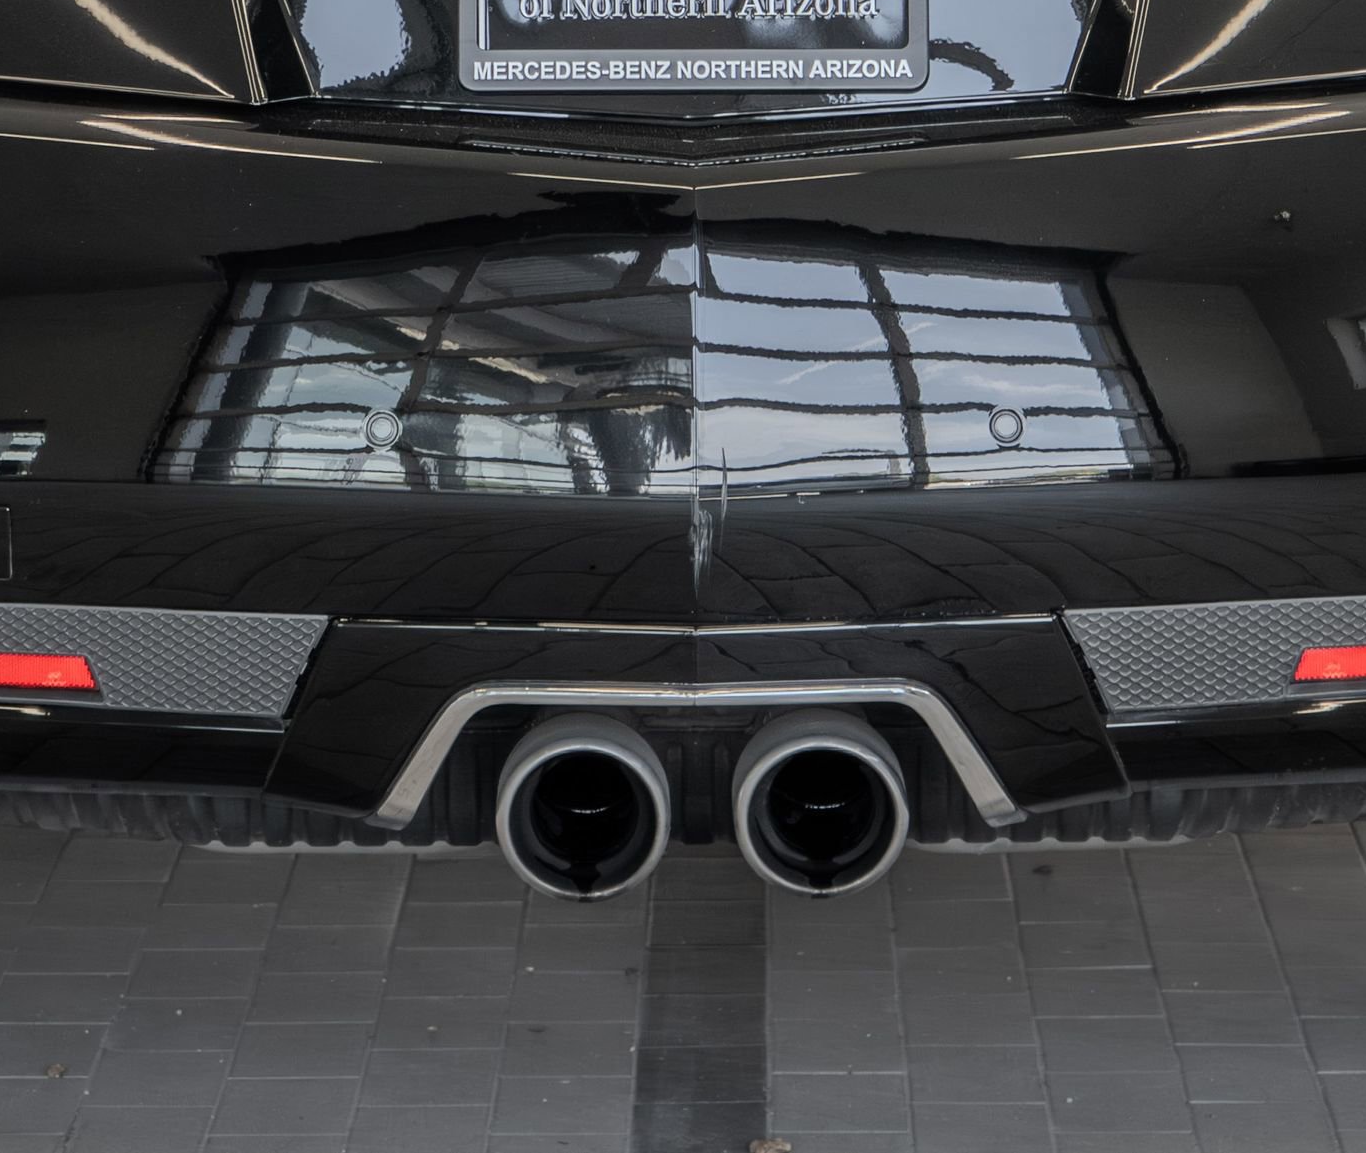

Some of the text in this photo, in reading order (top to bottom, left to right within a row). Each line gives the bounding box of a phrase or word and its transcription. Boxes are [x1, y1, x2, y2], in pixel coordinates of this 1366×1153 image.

[473, 59, 914, 81] MERCEDES-BENZ NORTHERN ARIZONA
